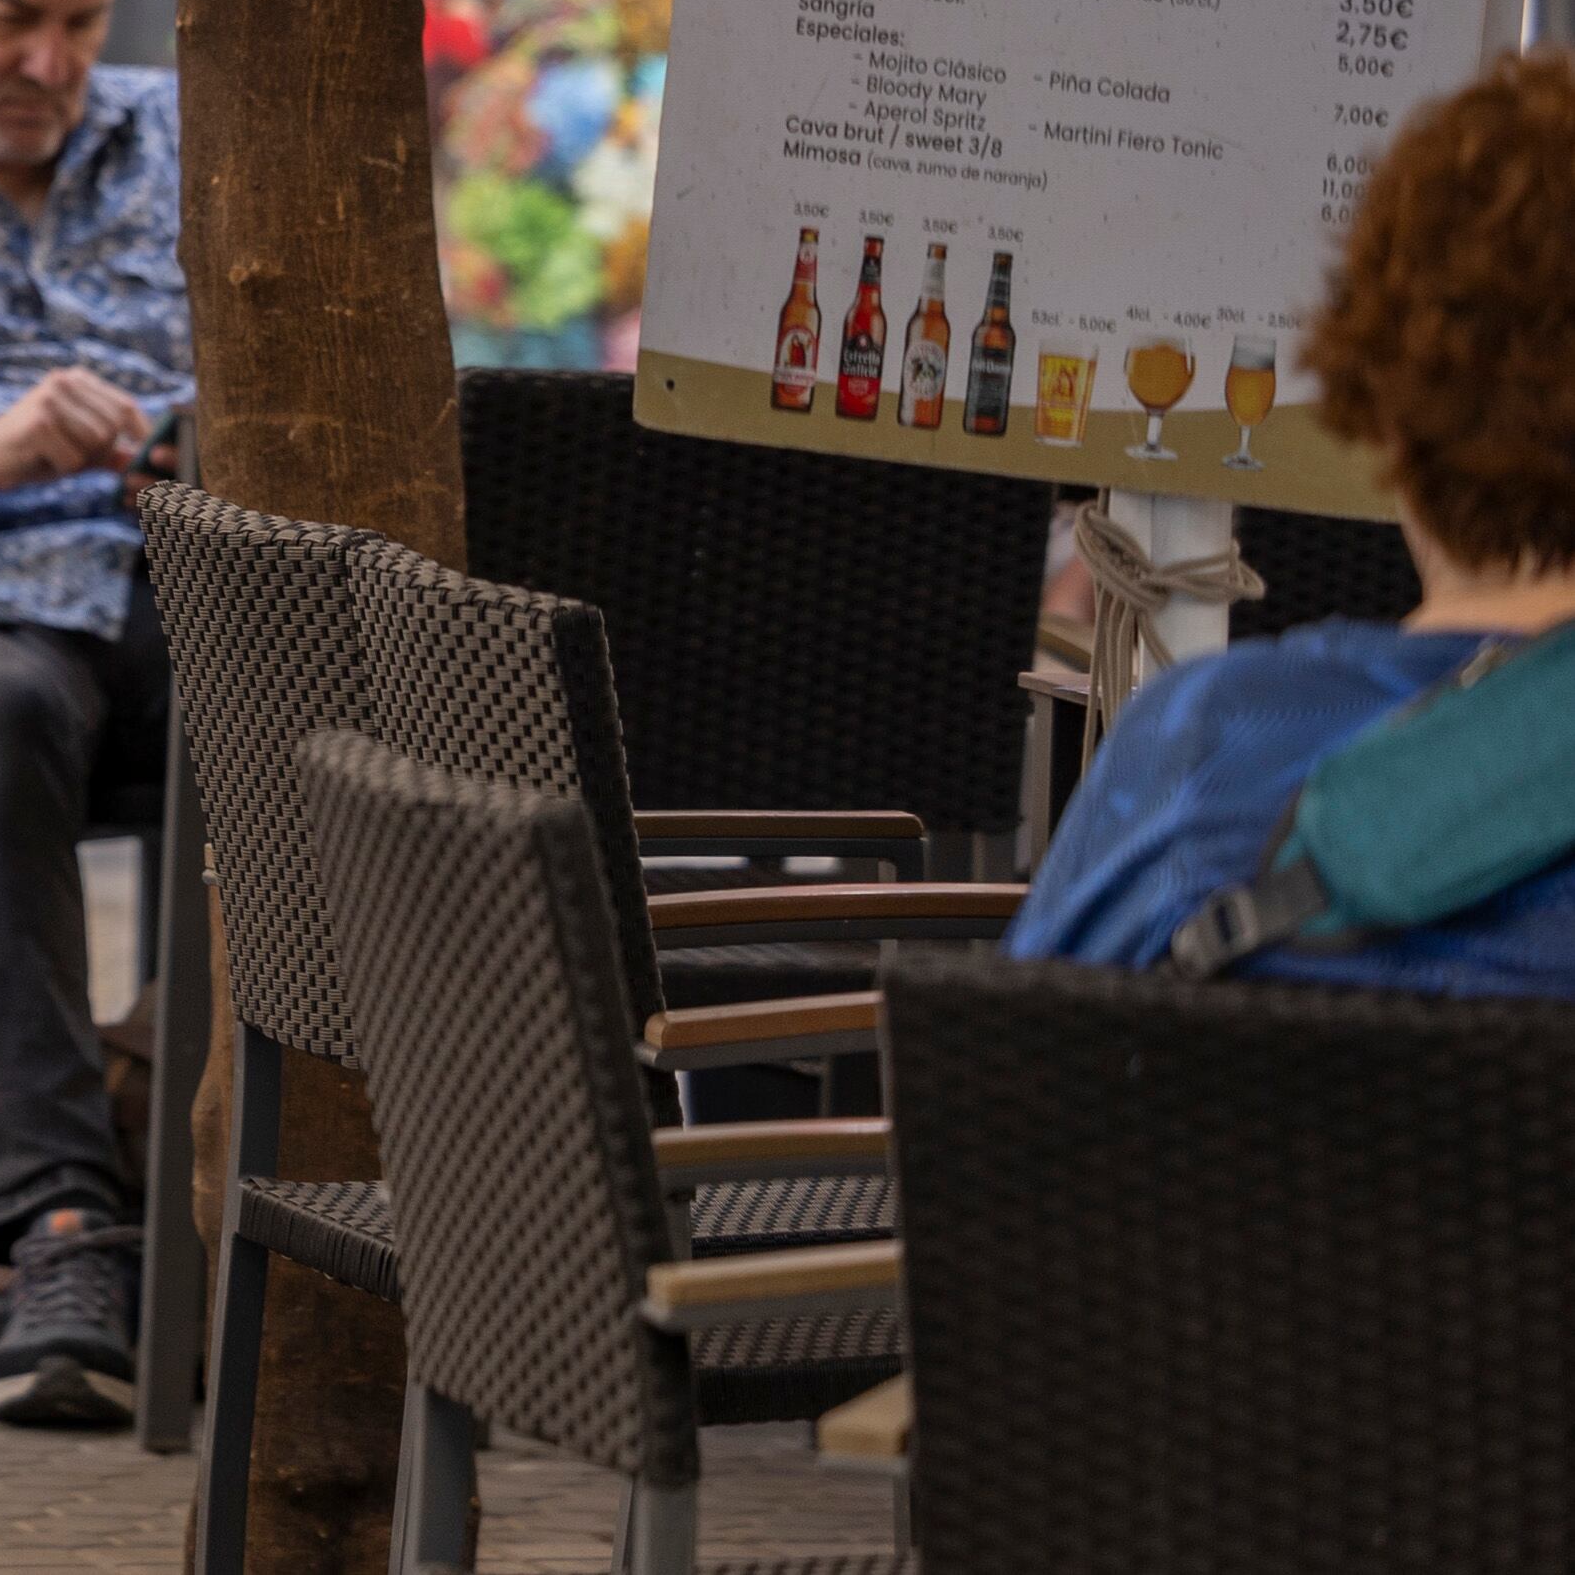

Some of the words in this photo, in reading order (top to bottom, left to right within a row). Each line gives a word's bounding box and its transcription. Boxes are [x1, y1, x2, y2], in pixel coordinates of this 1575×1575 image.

[795, 15, 905, 47] Especiales:
[868, 50, 928, 76] Mojito
[933, 57, 1007, 84] Clásico
[1338, 52, 1394, 78] 5,00€
[866, 74, 932, 108] Bloody
[938, 83, 987, 111] Mary
[1049, 70, 1091, 94] Piña
[1097, 76, 1170, 103] Colada
[864, 98, 928, 129] Aperol
[933, 108, 986, 132] Spritz
[1335, 103, 1388, 127] 7,00€
[785, 114, 838, 138] Cava
[843, 120, 884, 144] brut
[905, 132, 963, 153] sweet
[968, 133, 1003, 160] 3/8
[1043, 120, 1112, 146] Martini
[1117, 128, 1165, 153] Fiero
[1172, 134, 1223, 160] Tonic
[782, 138, 862, 167] Mimosa
[916, 160, 957, 179] zumo
[960, 165, 980, 181] de
